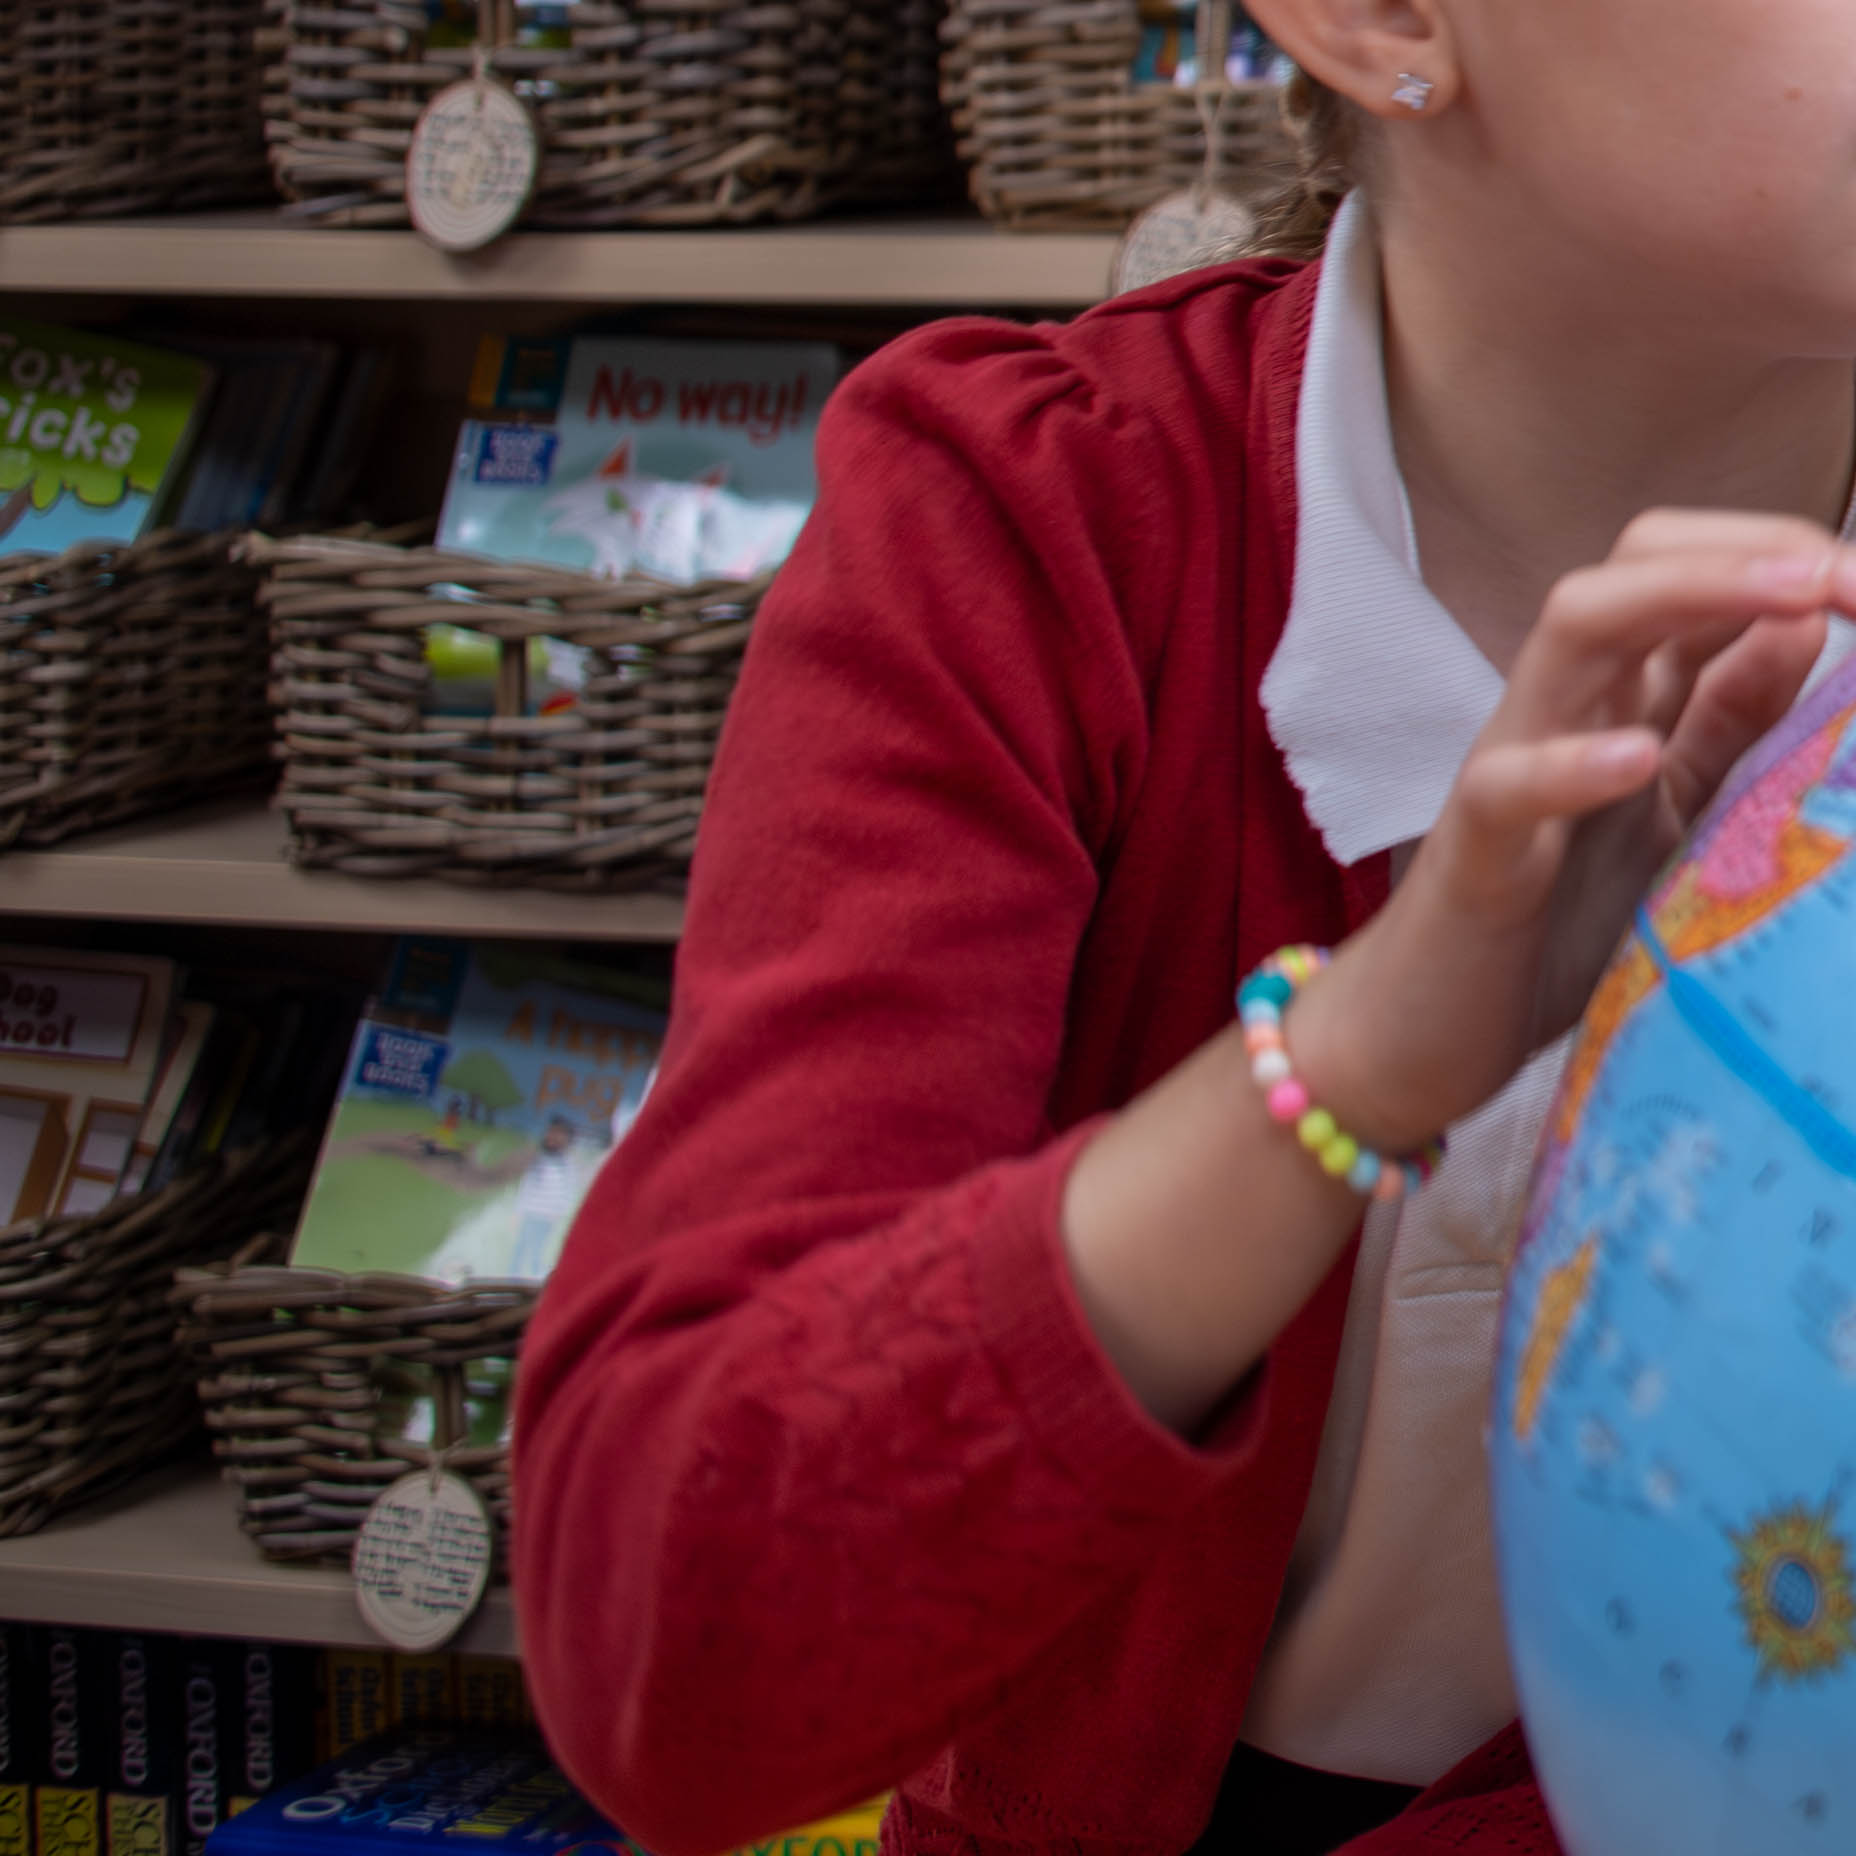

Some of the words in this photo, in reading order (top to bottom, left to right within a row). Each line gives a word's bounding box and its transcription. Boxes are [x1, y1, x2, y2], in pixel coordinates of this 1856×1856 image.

[586, 364, 664, 424] No
[676, 370, 810, 446] way!
[52, 1641, 79, 1778] OXFORD
[119, 1648, 148, 1786] OXFORD
[185, 1676, 218, 1835] OXFORD
[246, 1651, 274, 1790] OXFORD
